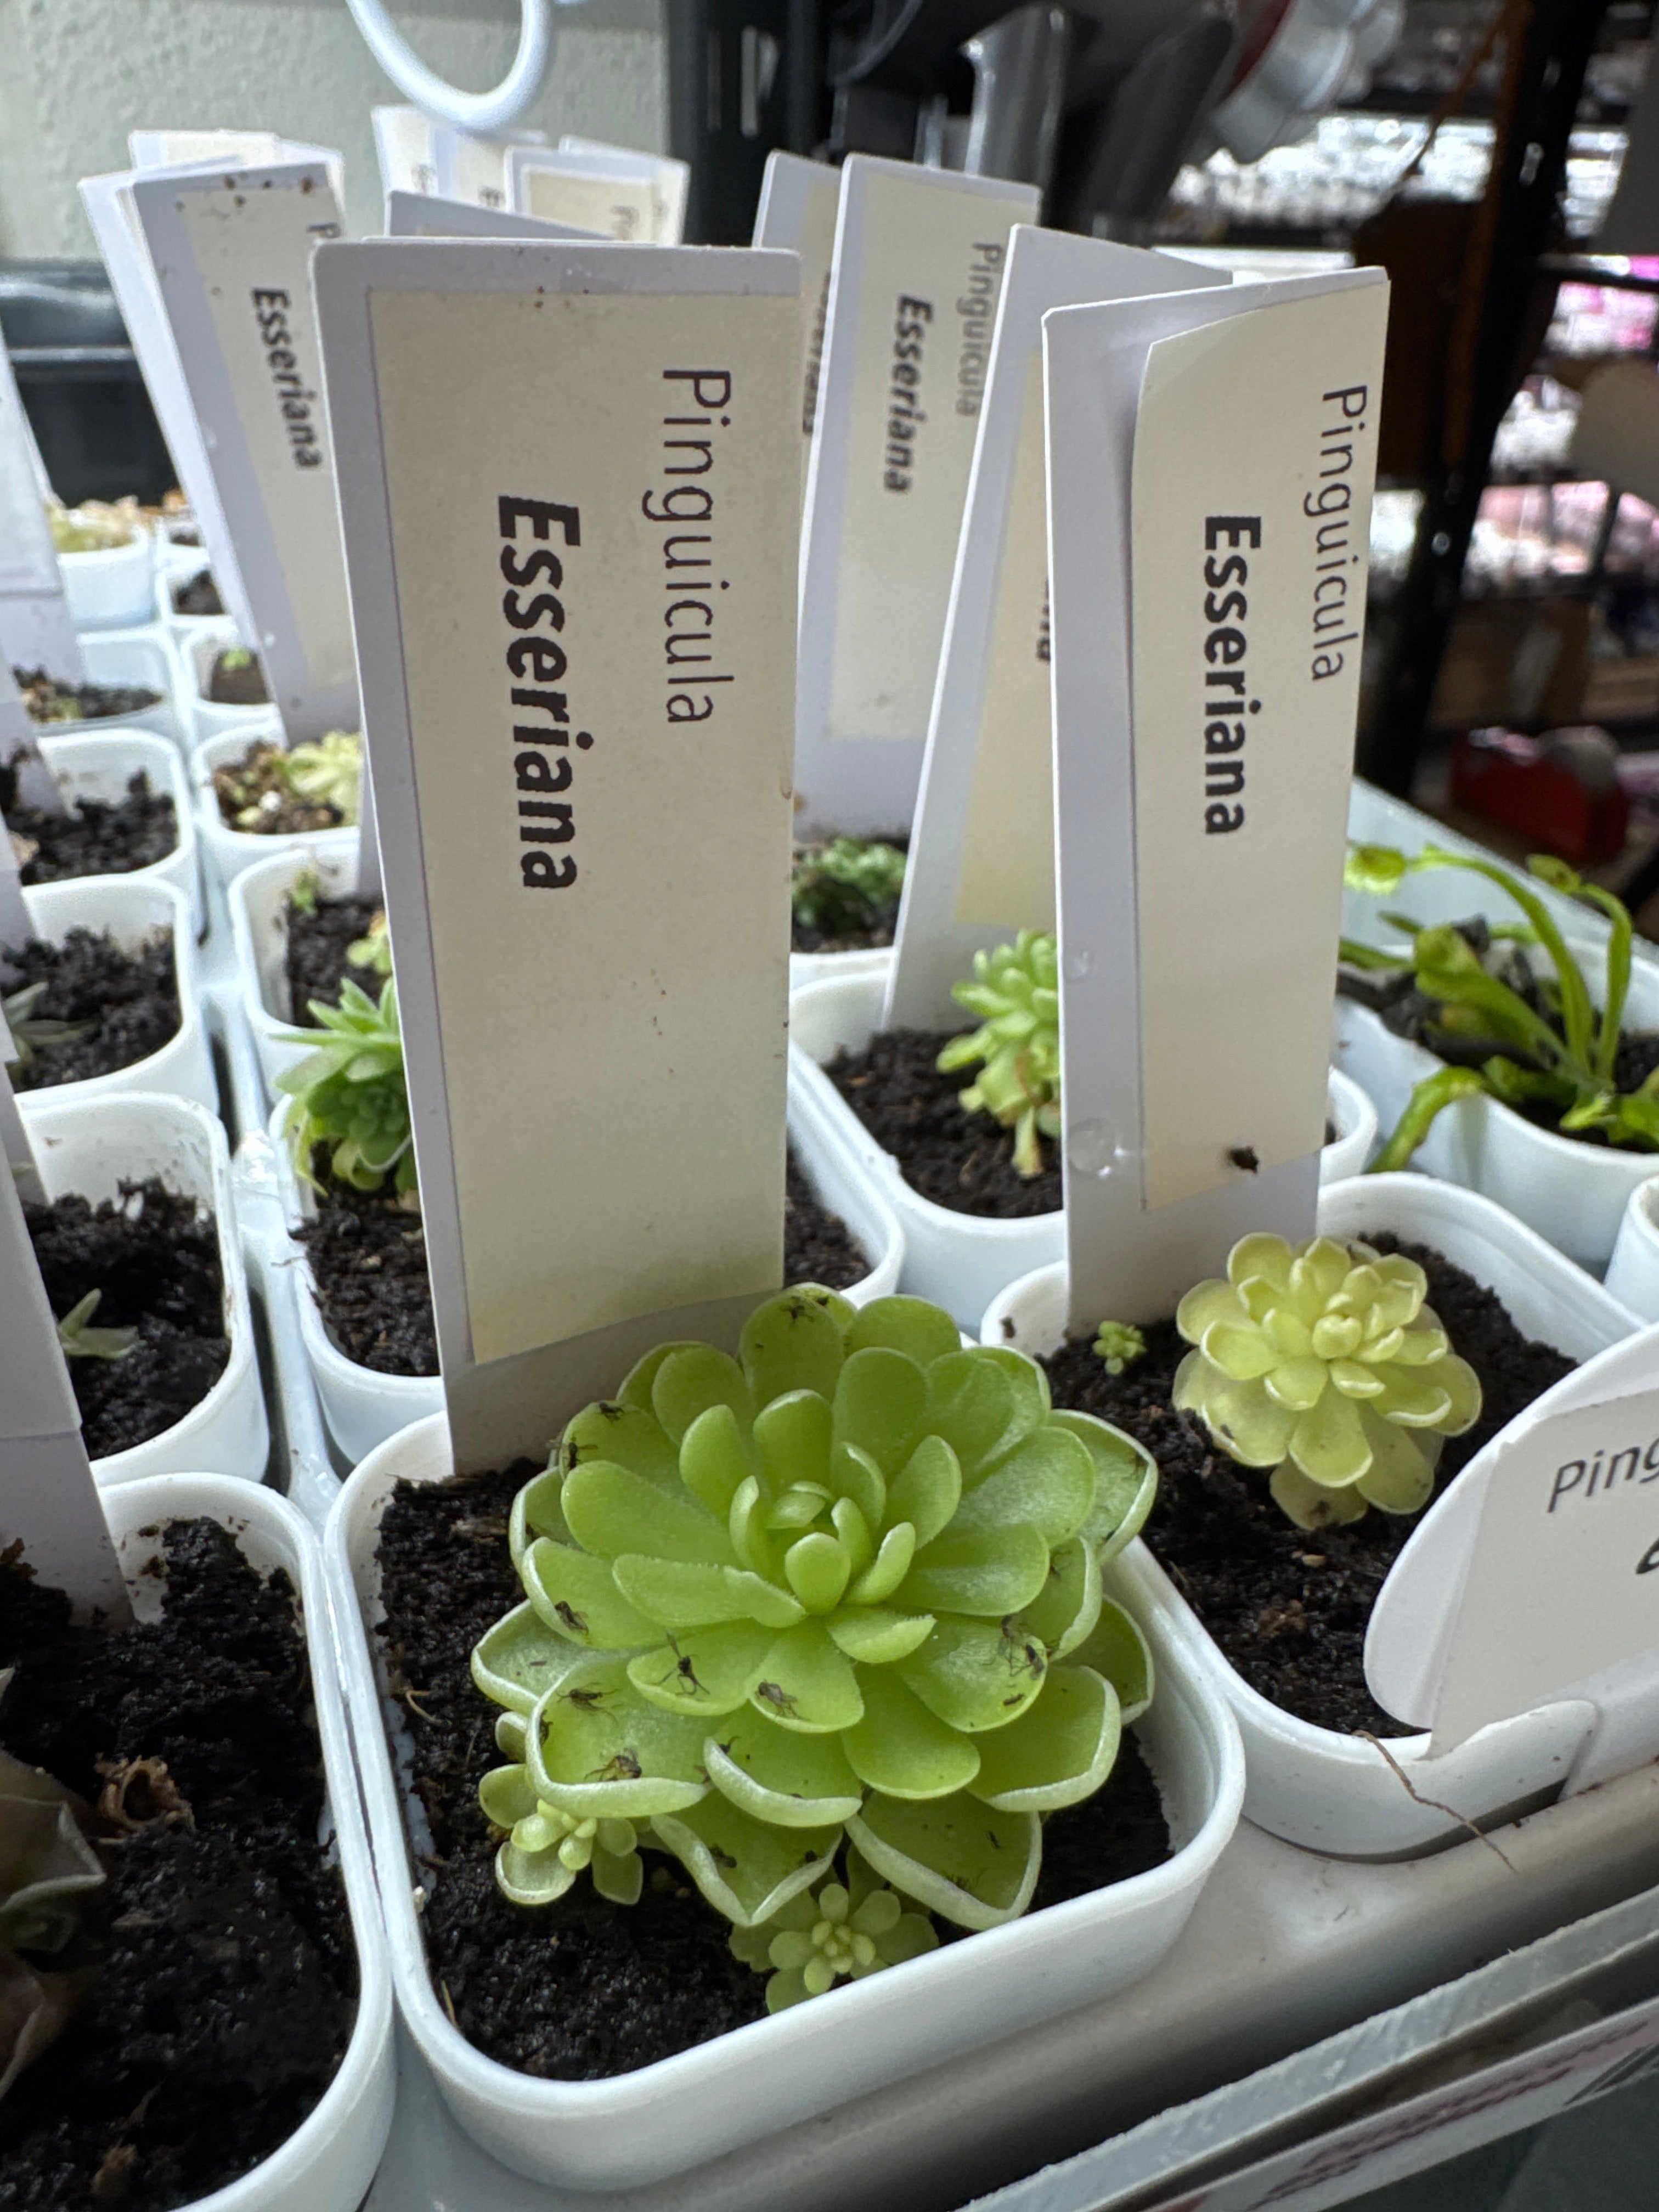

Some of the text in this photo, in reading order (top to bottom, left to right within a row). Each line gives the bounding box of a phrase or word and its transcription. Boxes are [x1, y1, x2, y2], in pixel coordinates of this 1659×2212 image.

[251, 286, 324, 469] Esseriana
[884, 294, 934, 493] Esseriana
[642, 369, 735, 723] Pinguicula
[1203, 515, 1262, 836] Esseriana
[1303, 385, 1368, 681] Pinguicula
[498, 495, 594, 889] Esseriana
